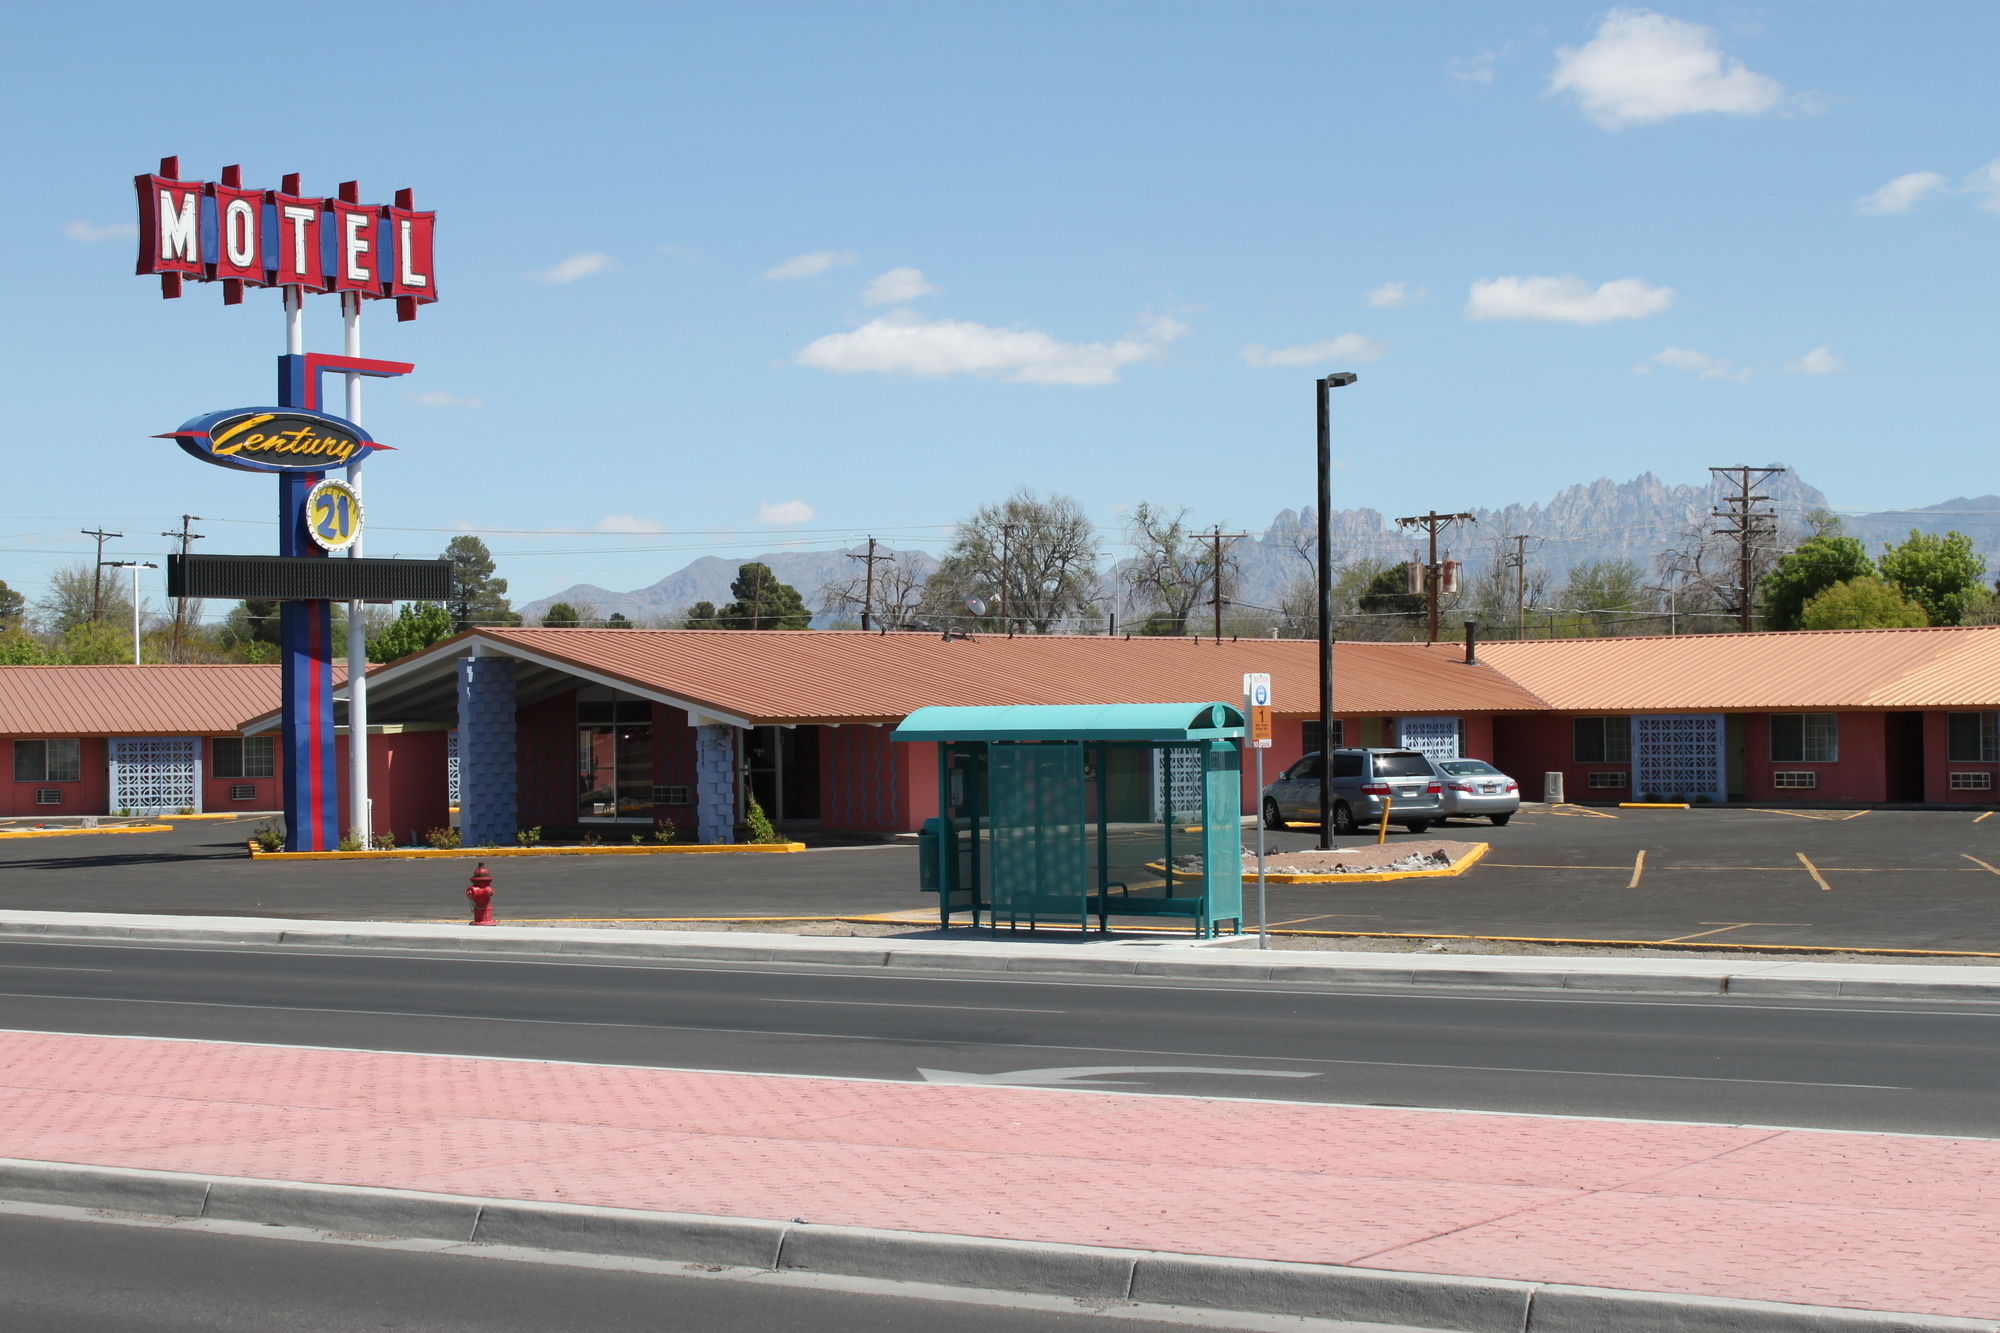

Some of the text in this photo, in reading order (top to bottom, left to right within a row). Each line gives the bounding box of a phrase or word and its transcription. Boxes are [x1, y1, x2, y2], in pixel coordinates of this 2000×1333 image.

[159, 188, 427, 287] MOTEL
[211, 413, 356, 465] Century
[315, 493, 350, 540] 21
[1259, 709, 1264, 723] 1
